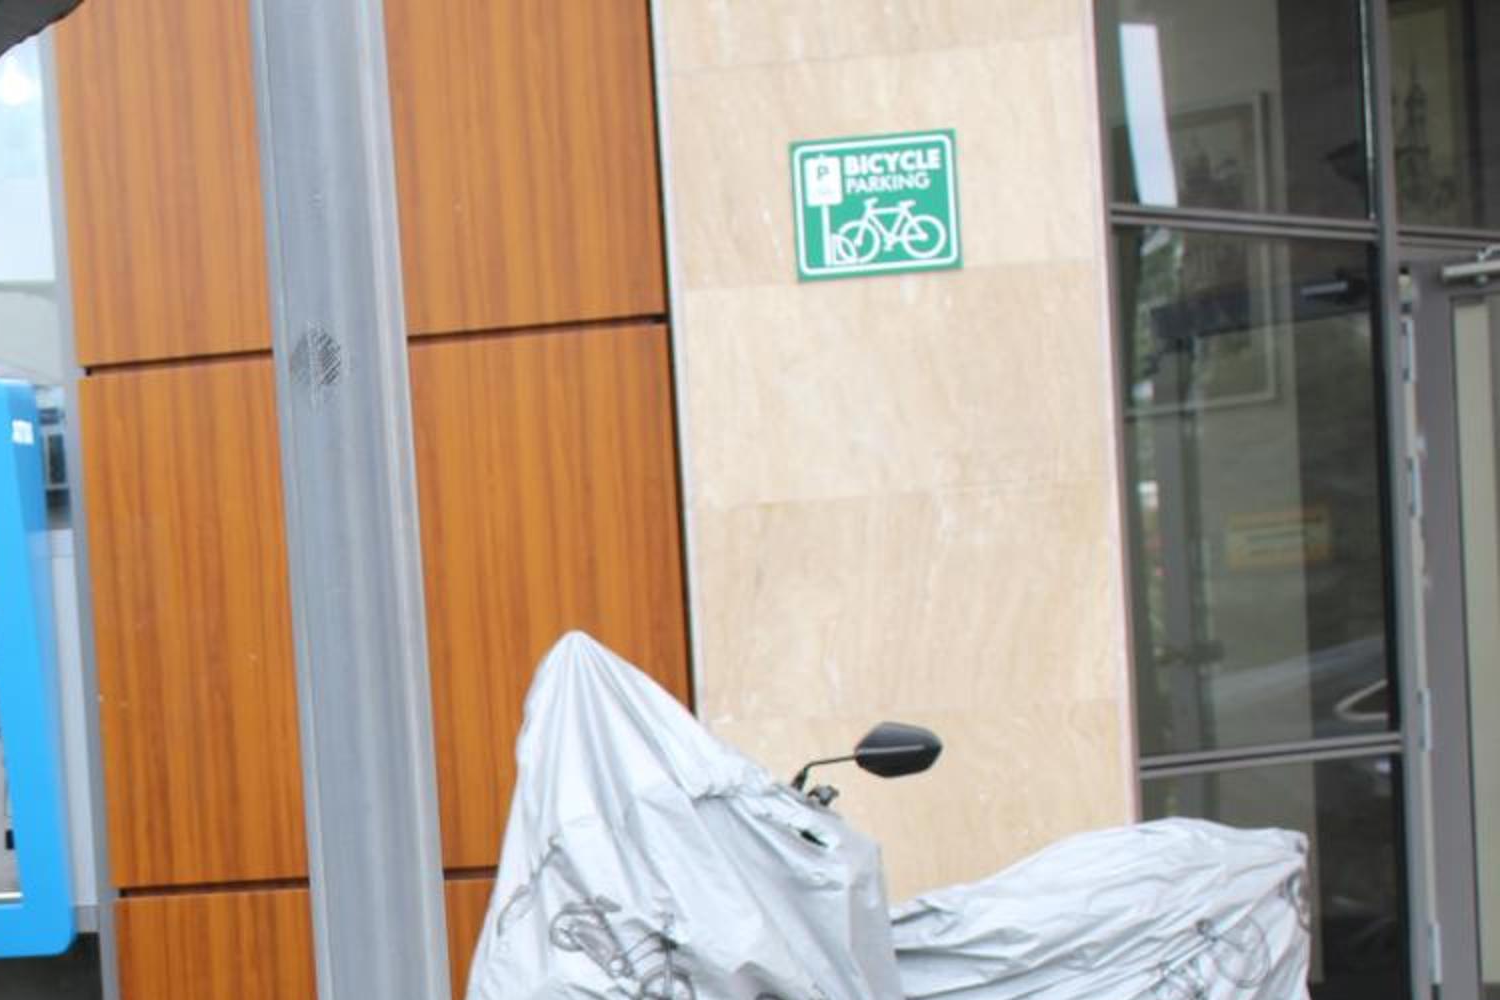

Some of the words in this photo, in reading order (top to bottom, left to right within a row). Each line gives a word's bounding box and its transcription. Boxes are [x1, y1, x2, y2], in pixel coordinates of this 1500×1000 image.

[817, 165, 831, 181] P
[844, 148, 940, 175] BICYCLE
[846, 171, 931, 194] PARKING
